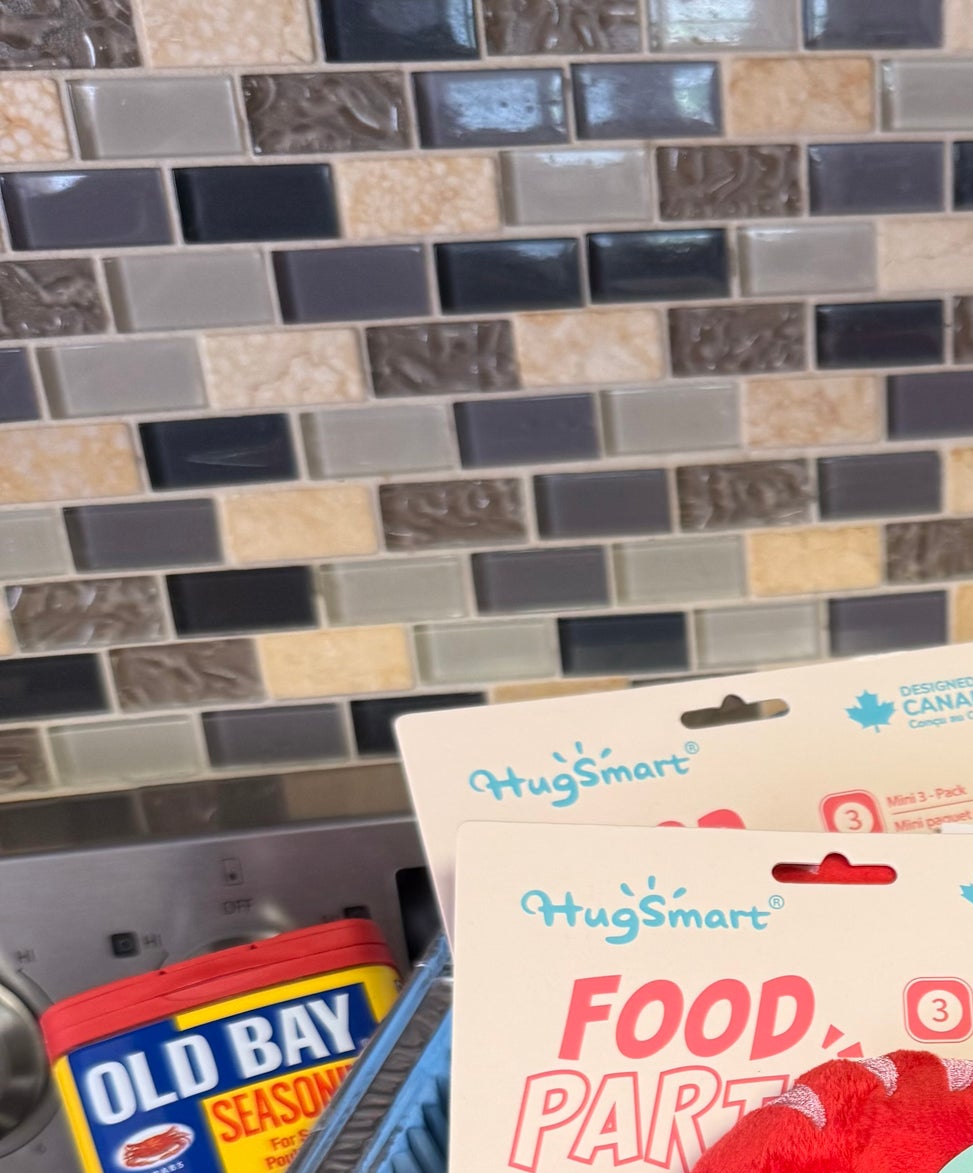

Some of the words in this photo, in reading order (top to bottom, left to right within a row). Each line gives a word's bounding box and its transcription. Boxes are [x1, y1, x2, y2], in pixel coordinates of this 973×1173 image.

[950, 714, 965, 723] au
[887, 791, 916, 808] Mini
[917, 791, 928, 803] 3
[935, 785, 968, 800] Pack
[844, 809, 863, 831] 3
[894, 815, 924, 832] Mini
[558, 974, 815, 1062] FOOD
[931, 998, 949, 1023] 3
[87, 1033, 219, 1125] OLD
[228, 993, 356, 1079] BAY
[212, 1064, 353, 1143] SEASON
[271, 1134, 297, 1151] For
